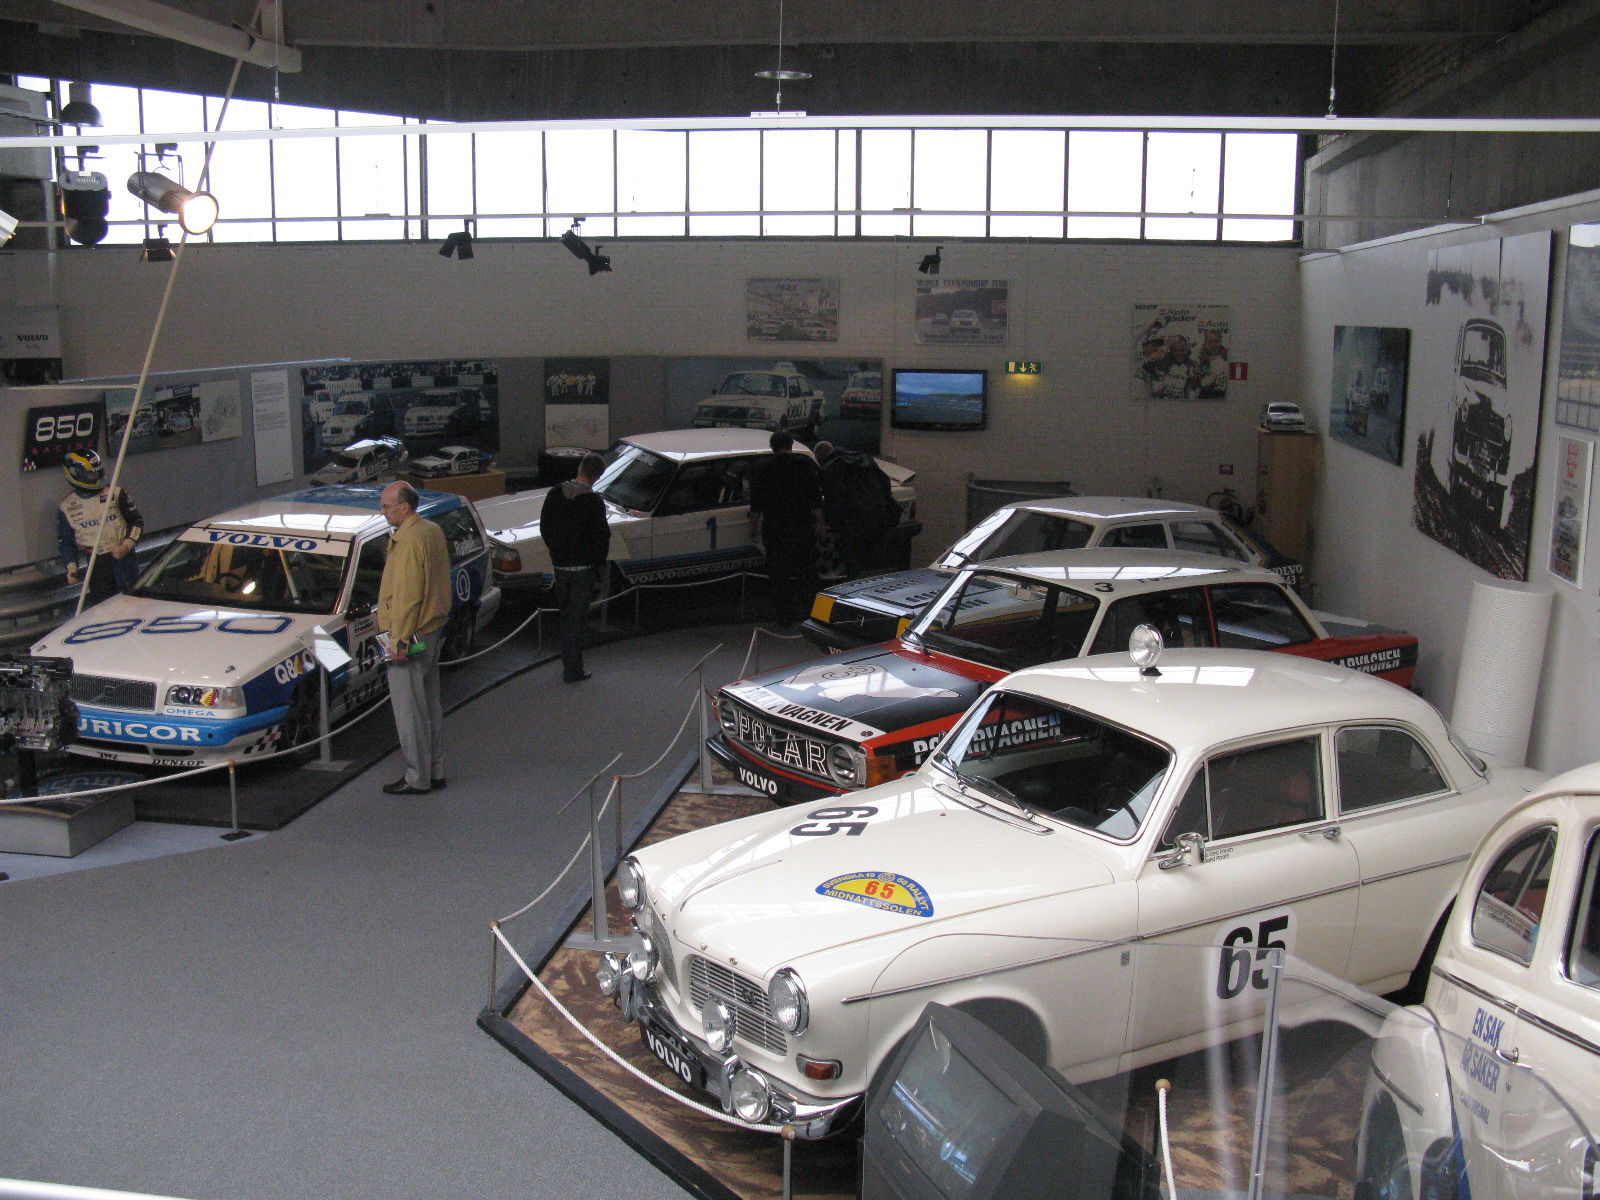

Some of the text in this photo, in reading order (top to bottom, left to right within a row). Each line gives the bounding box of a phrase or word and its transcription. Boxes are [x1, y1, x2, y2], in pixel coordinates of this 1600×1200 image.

[17, 334, 48, 342] VOLVO
[36, 413, 94, 442] 850
[31, 440, 95, 455] RACING
[80, 514, 117, 528] VOO
[706, 517, 717, 550] 1
[208, 531, 318, 551] VOLVO
[629, 571, 676, 585] VOLVO
[1095, 582, 1115, 593] 3
[62, 617, 295, 646] 850
[275, 658, 298, 684] Q8
[166, 708, 215, 717] OMEGA
[777, 703, 854, 731] VAGNEN
[737, 710, 828, 776] POLAR
[152, 758, 204, 767] DUNLOP
[739, 766, 778, 795] VOLVO
[789, 806, 879, 836] 65
[824, 888, 923, 916] MIDNATTSSOLEN
[864, 880, 896, 900] 65
[1216, 915, 1289, 1000] 65
[1472, 1007, 1505, 1048] EN SAK
[646, 1029, 692, 1083] VOLVO
